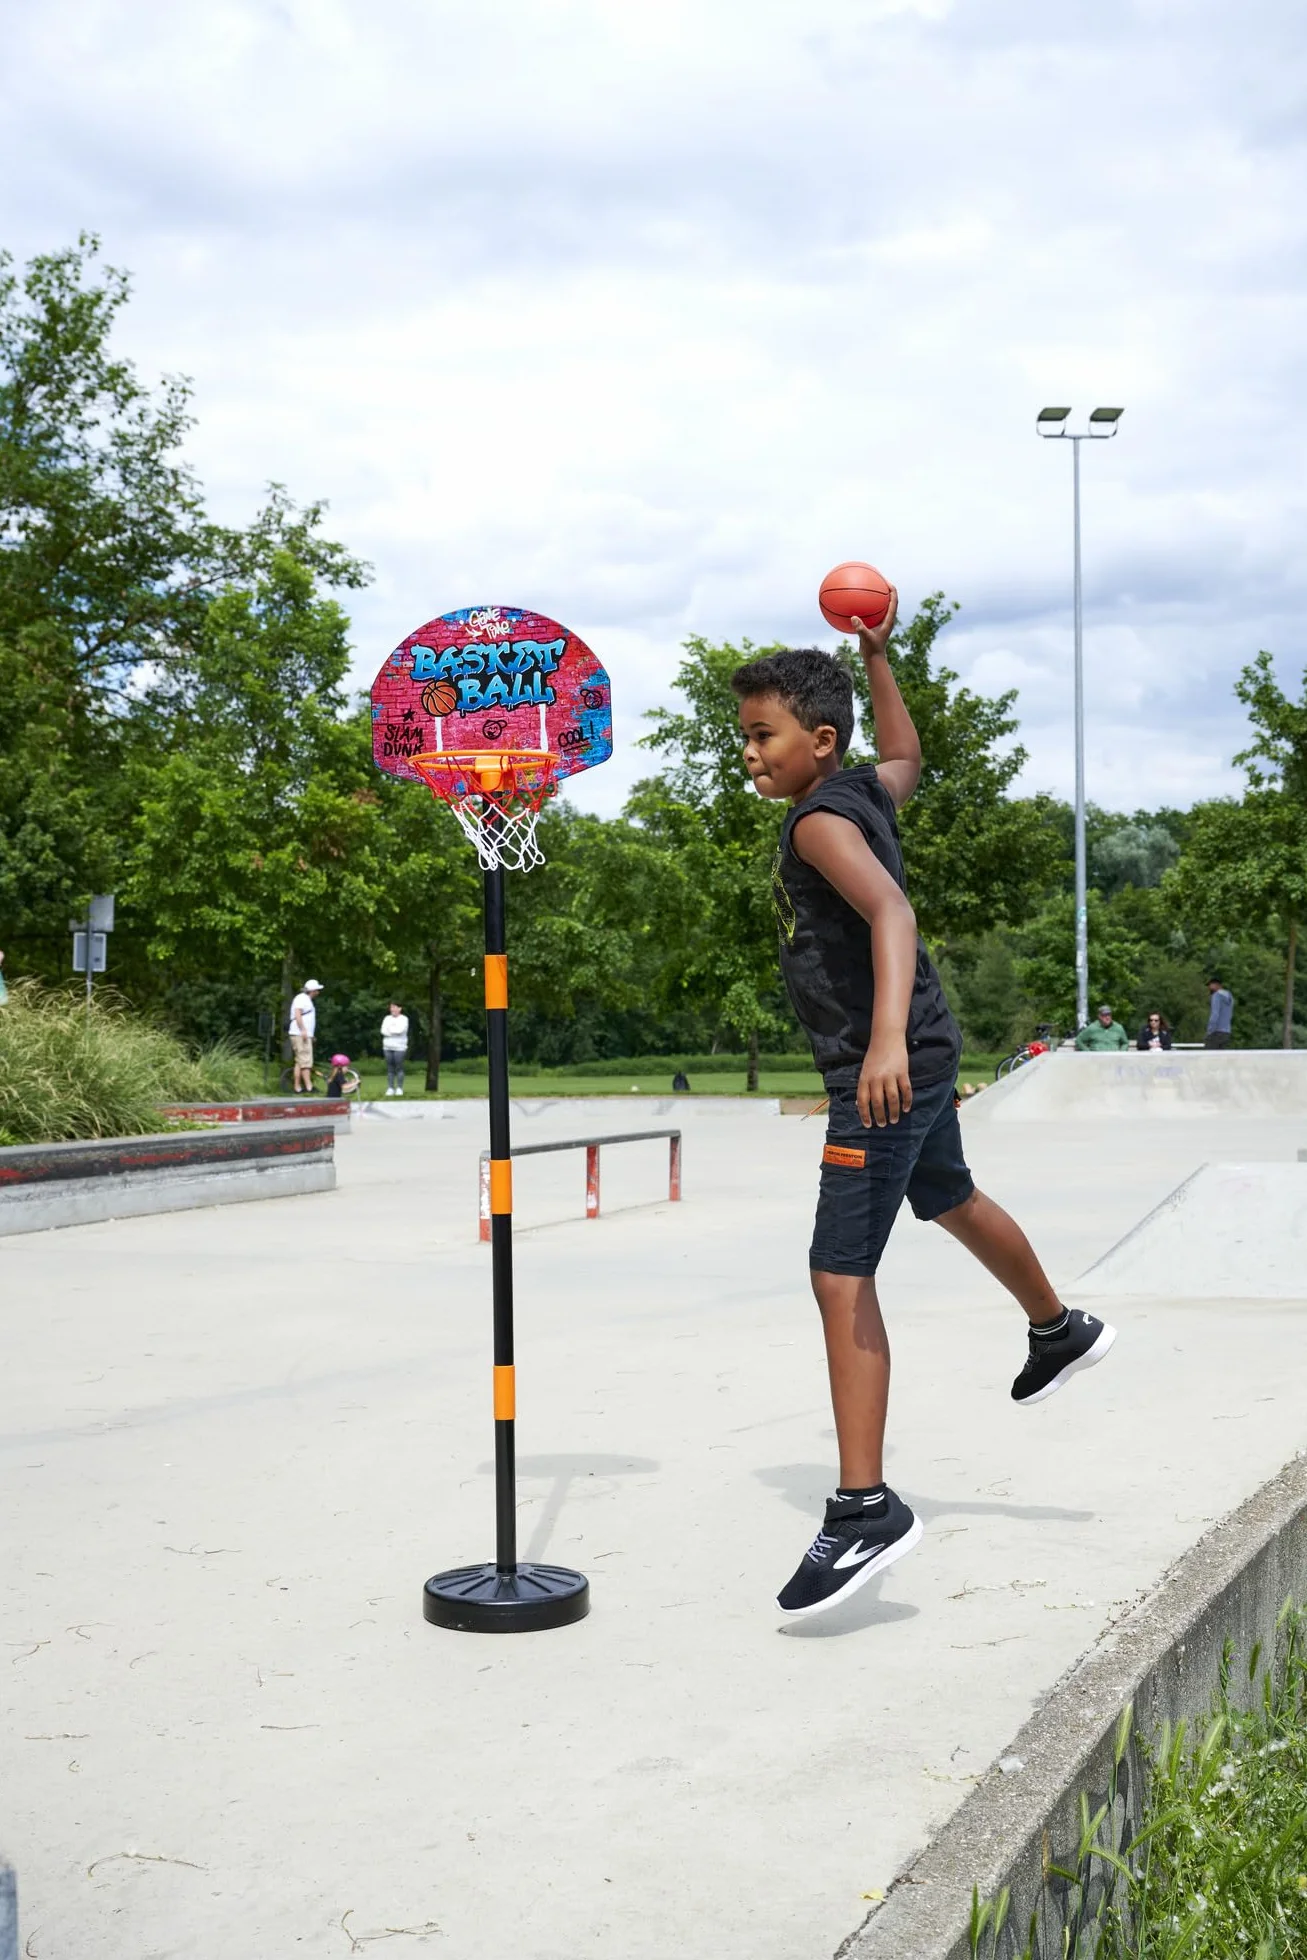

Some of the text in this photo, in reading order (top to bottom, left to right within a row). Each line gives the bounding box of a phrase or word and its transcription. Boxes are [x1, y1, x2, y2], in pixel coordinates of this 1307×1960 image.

[410, 638, 566, 680] BASKET
[457, 672, 556, 711] BALL
[385, 724, 424, 743] SLAM
[384, 742, 424, 757] DUNK
